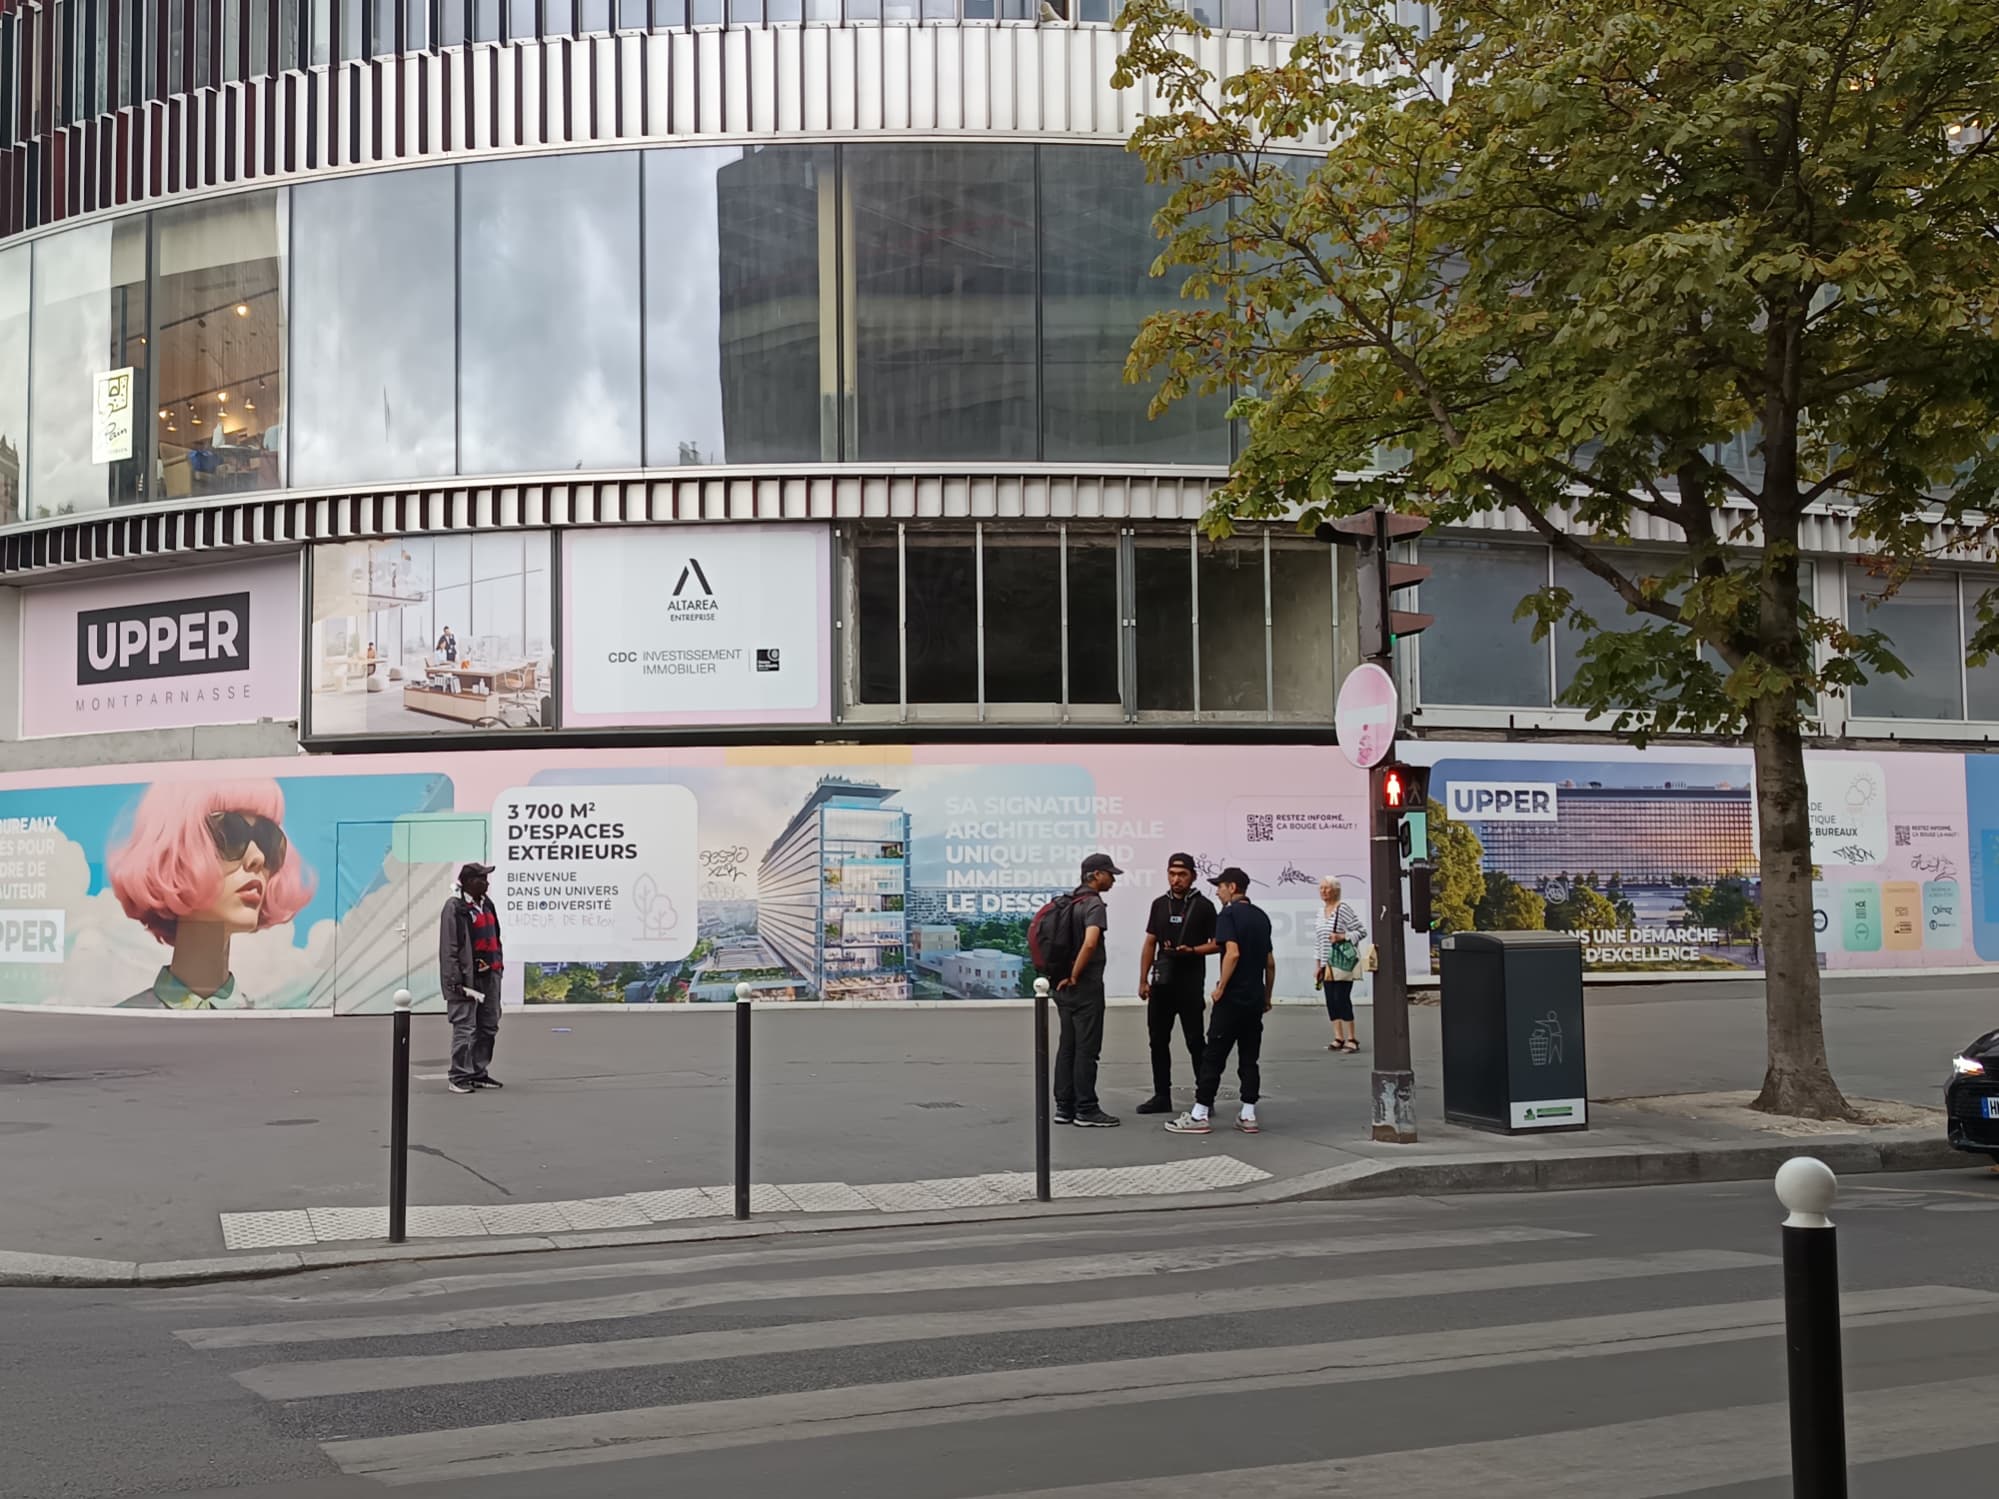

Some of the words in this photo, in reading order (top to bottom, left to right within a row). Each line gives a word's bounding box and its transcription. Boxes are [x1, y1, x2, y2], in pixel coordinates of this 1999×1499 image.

[667, 600, 719, 611] ALTAREA
[670, 613, 716, 622] ENTREPRISE
[88, 609, 239, 670] UPPER
[608, 652, 637, 663] CDC
[642, 649, 742, 662] INVESTISSEMENT
[642, 663, 716, 675] IMMOBILIER
[76, 684, 251, 712] MONTPARNASSE
[946, 797, 978, 815] SA
[984, 796, 1123, 815] SIGNATURE
[1455, 789, 1549, 813] UPPER
[507, 804, 519, 819] 3
[525, 803, 564, 819] 700
[508, 823, 625, 840] D'ESPACES
[946, 821, 1165, 839] ARCHITECTURALE
[1815, 827, 1858, 837] BUREAUX
[17, 839, 55, 855] POUR
[507, 841, 638, 861] EXTÉRIEURS
[946, 845, 1042, 867] UNIQUE
[28, 861, 47, 877] DE
[507, 872, 577, 882] BIENVENUE
[507, 886, 541, 896] DANS
[544, 886, 561, 896] UN
[565, 885, 619, 896] UNIVERS
[507, 901, 524, 911] DE
[527, 898, 612, 911] BIODIVERSITÉ
[947, 894, 975, 912] LE
[1593, 928, 1627, 944] UNE
[1630, 926, 1719, 943] DÉMARCHE
[1586, 946, 1700, 963] D'EXCELLENCE
